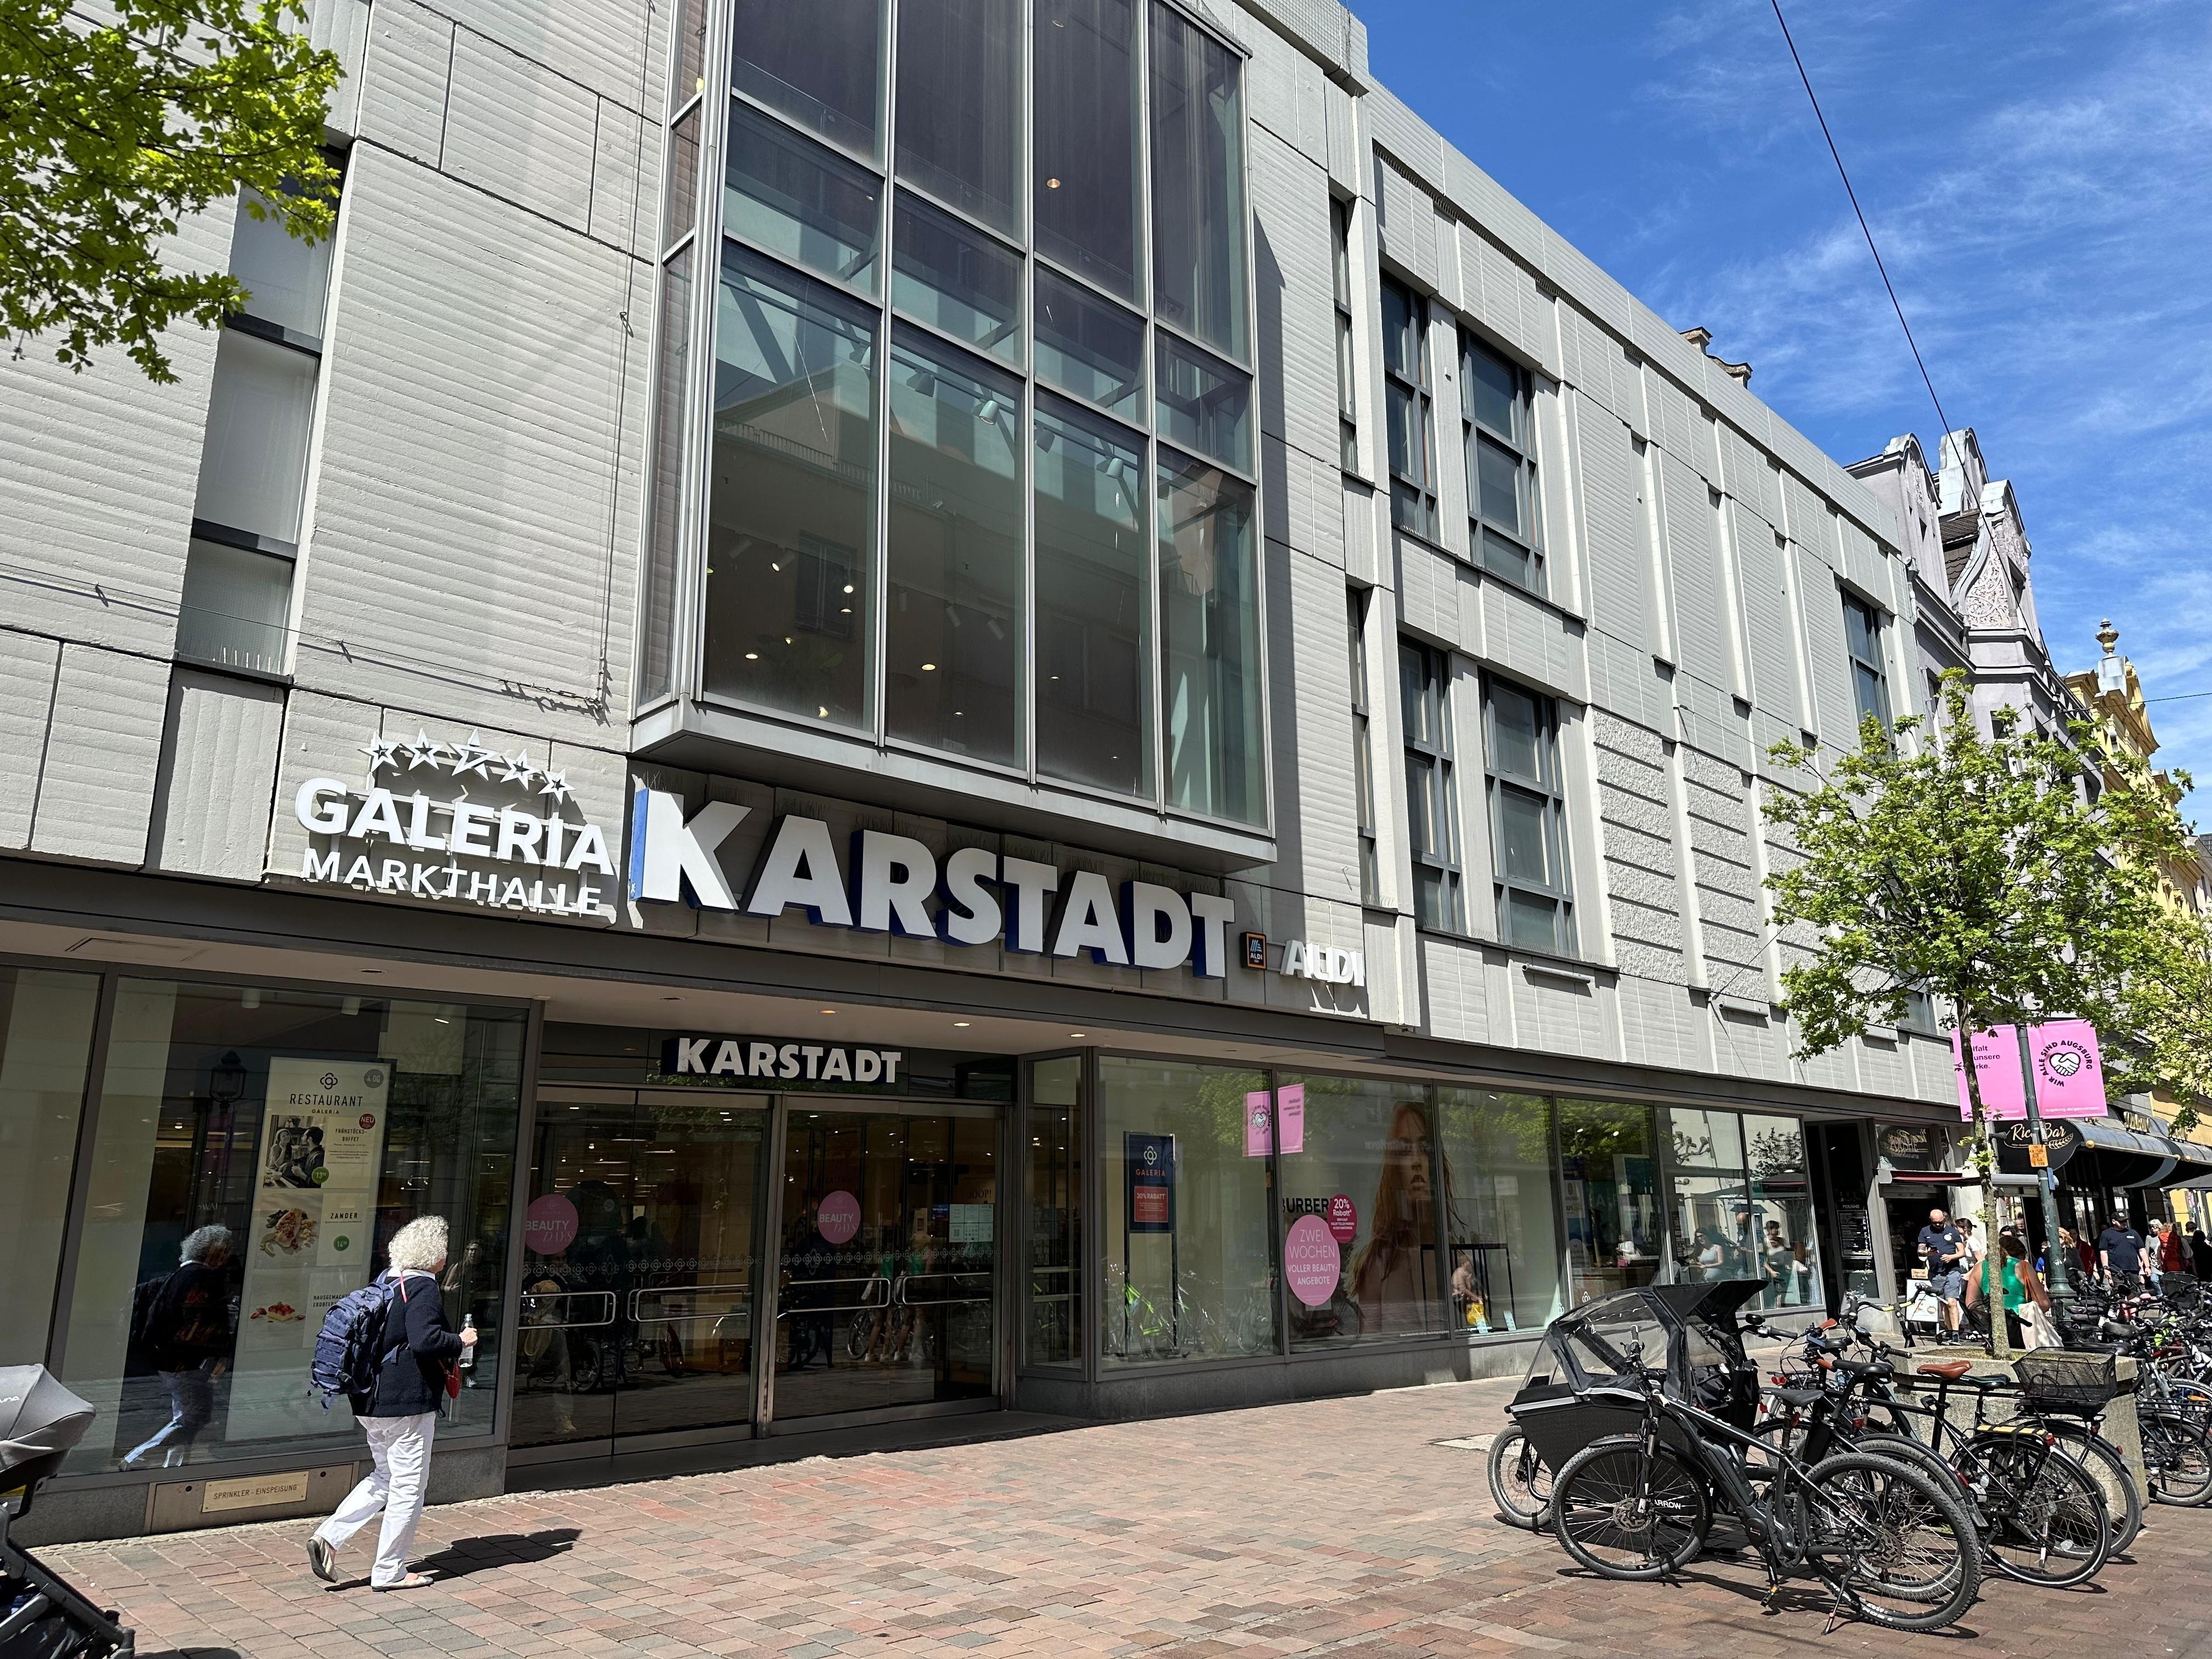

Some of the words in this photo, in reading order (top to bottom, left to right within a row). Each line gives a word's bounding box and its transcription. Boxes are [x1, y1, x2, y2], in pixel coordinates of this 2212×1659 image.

[295, 777, 615, 876] GALERIA
[303, 848, 602, 917] MARKTHALLE
[629, 787, 1235, 979] KARSTADT
[1280, 939, 1364, 987] ALDI
[2041, 1042, 2058, 1057] SIND
[2061, 1040, 2092, 1070] AUGSBURG
[676, 1037, 902, 1084] KARSTADT
[2039, 1058, 2049, 1076] ALLE
[2049, 1076, 2064, 1087] WIR
[290, 1093, 363, 1107] RESTAURANT
[2011, 1124, 2032, 1141] Ric
[1136, 1169, 1166, 1177] GALERIA
[969, 1189, 992, 1199] JOOP!
[1334, 1198, 1350, 1209] 20%
[526, 1220, 569, 1231] BEAUTY
[819, 1214, 854, 1223] BEAUTY
[1300, 1229, 1323, 1242] ZWEI
[1289, 1245, 1335, 1259] WOCHEN
[1288, 1264, 1311, 1273] VOLLER
[1312, 1263, 1338, 1272] BEAUTY-
[1297, 1276, 1330, 1285] ANGEBOTE
[213, 1489, 250, 1499] SPRINKLER
[256, 1484, 298, 1495] EINSPEISUNG
